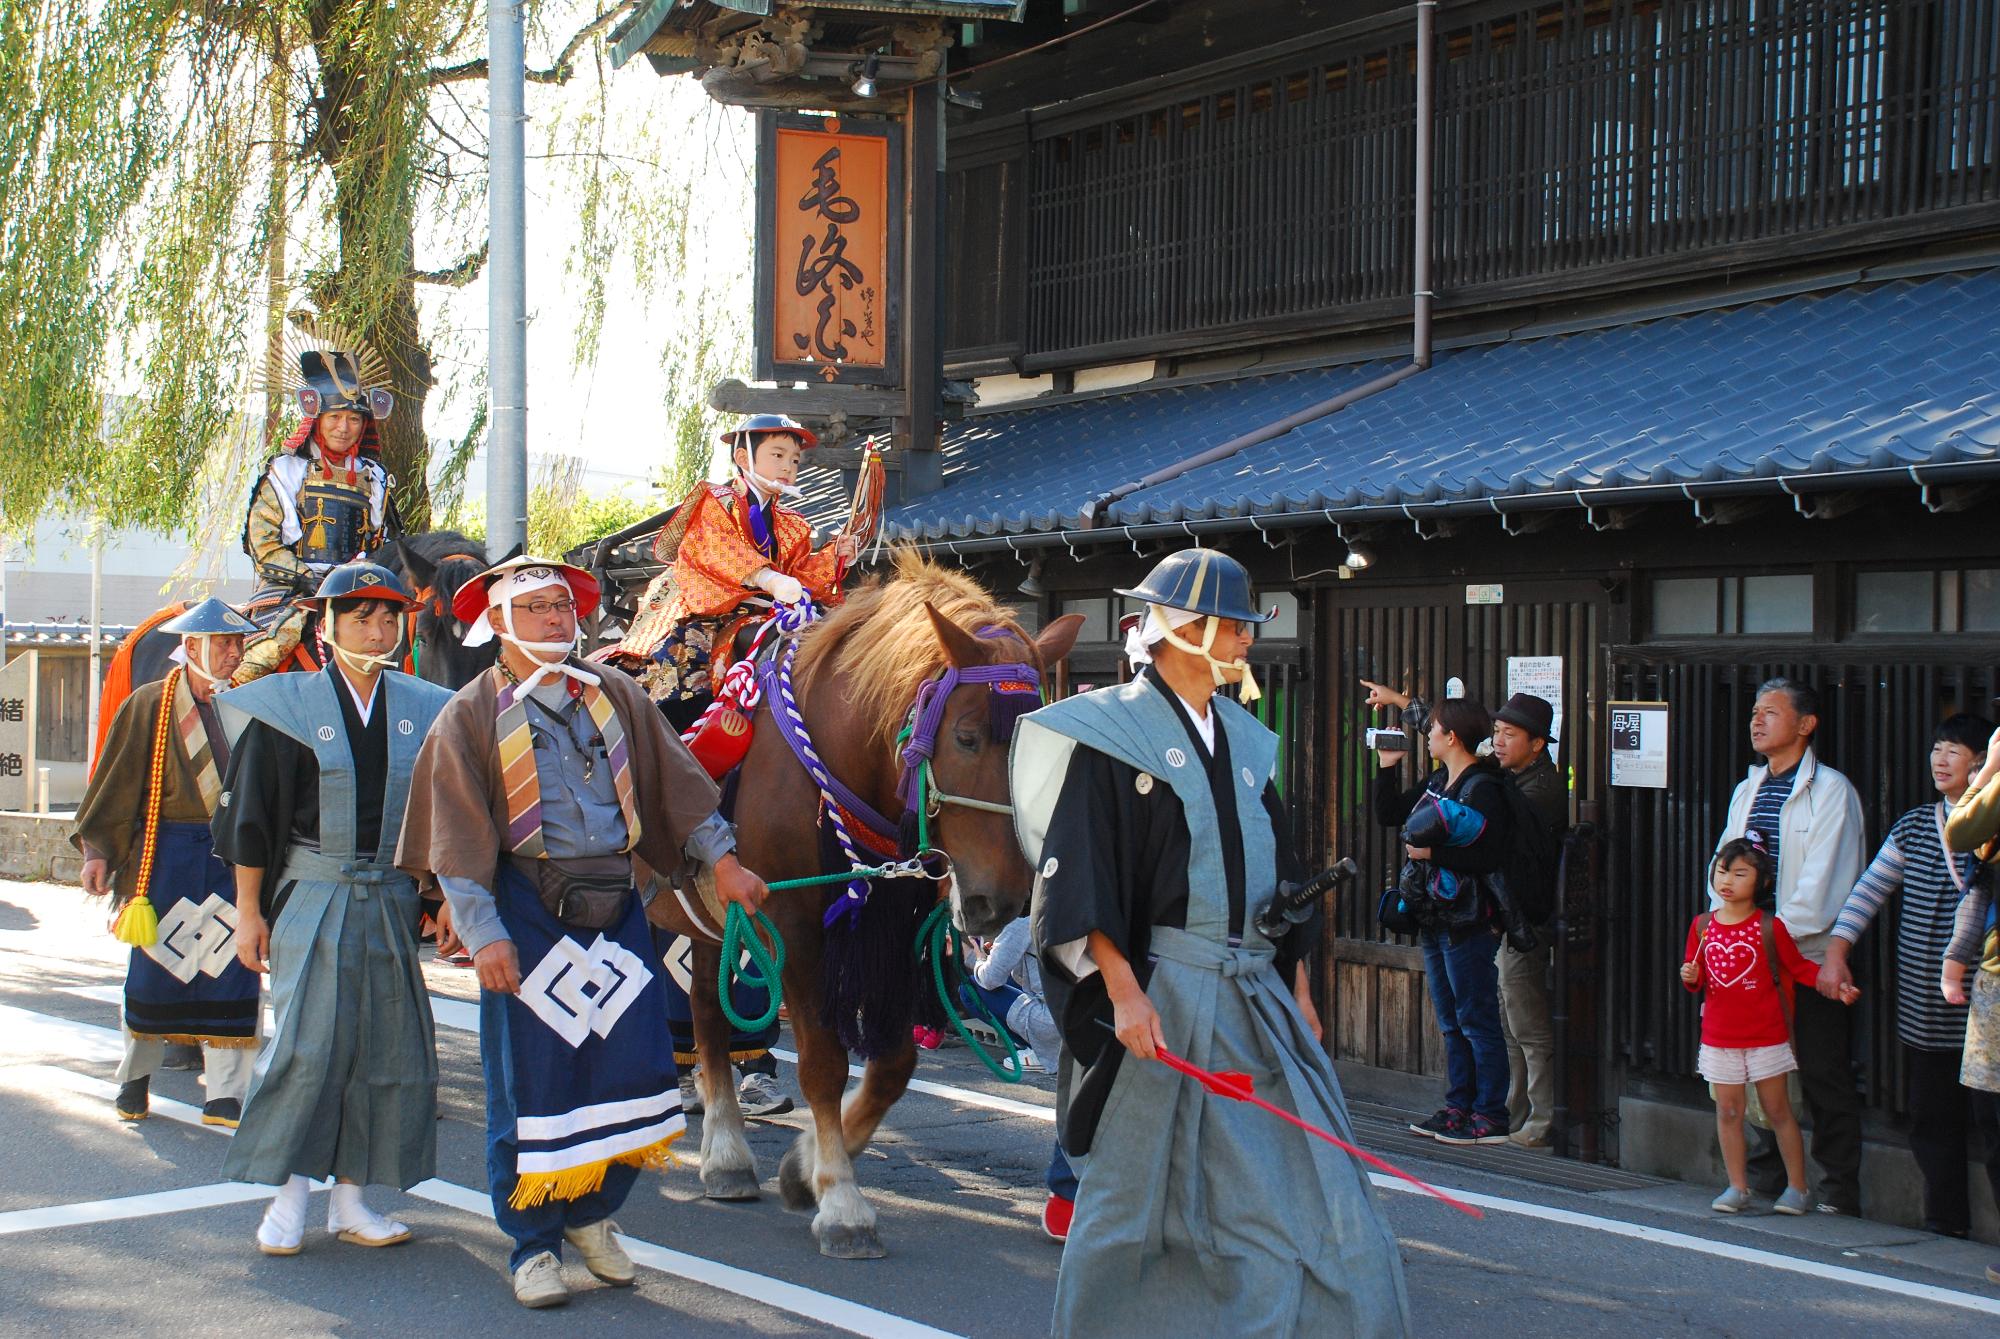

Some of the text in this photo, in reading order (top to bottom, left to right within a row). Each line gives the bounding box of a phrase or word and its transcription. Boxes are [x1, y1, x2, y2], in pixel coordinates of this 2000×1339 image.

[1613, 714, 1640, 733] 母屋
[1630, 735, 1638, 746] 3
[0, 697, 25, 812] 緒絶
